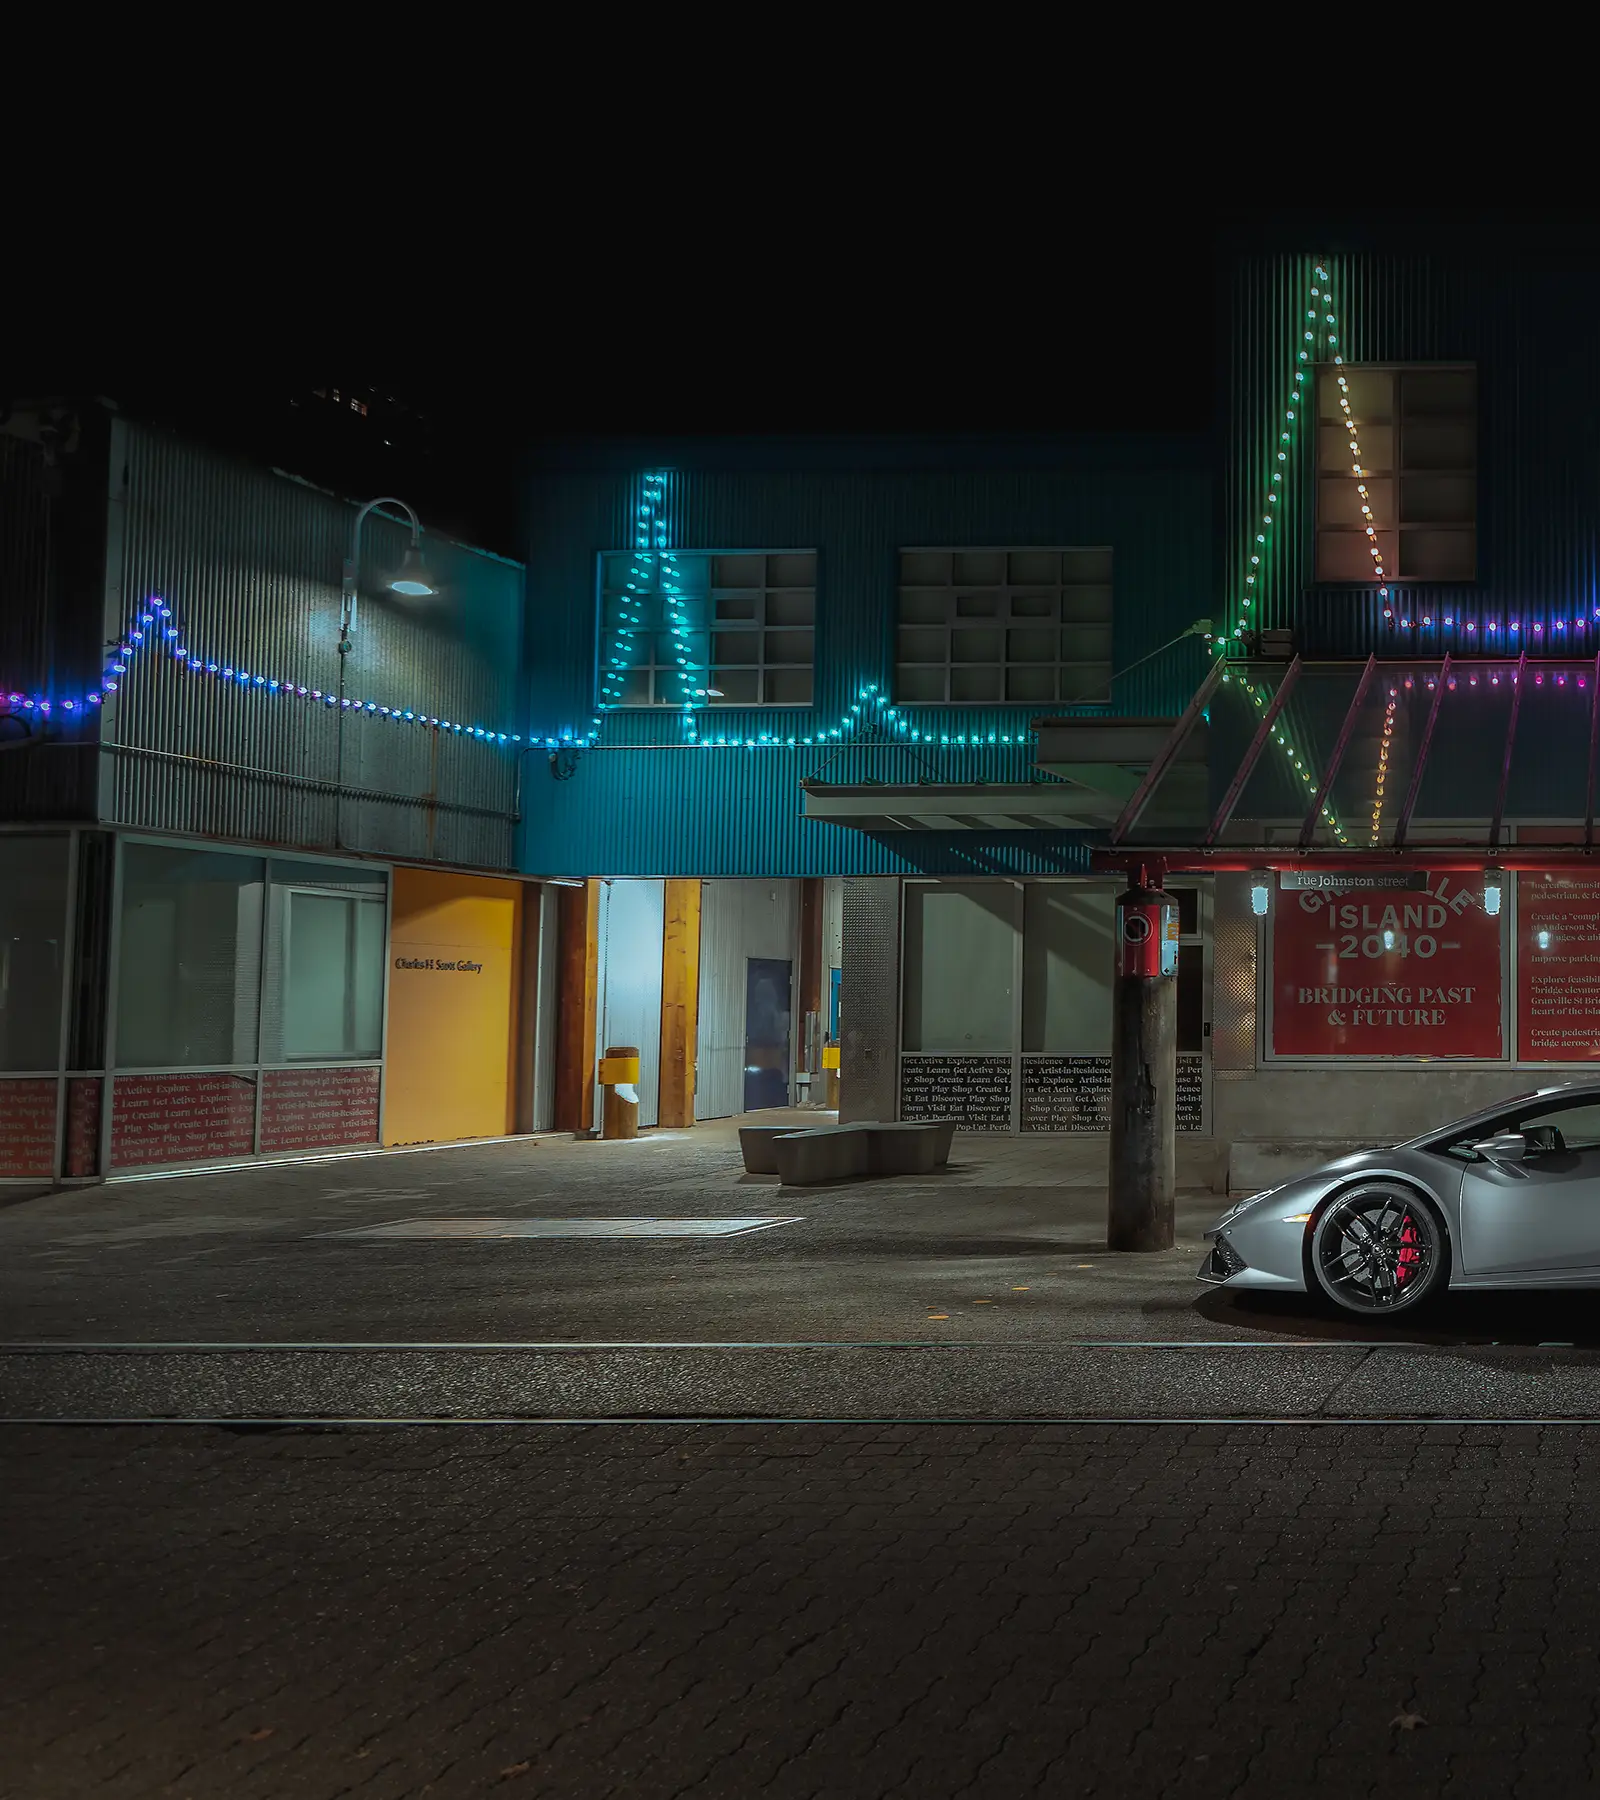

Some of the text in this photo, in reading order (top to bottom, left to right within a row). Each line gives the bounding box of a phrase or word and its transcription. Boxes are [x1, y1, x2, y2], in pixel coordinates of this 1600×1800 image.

[1318, 875, 1374, 887] Johnston
[1378, 876, 1408, 887] street
[1531, 892, 1580, 901] pedestrian,
[1329, 905, 1447, 929] ISLAND
[1531, 913, 1559, 921] Create
[1541, 923, 1584, 931] Anderson
[1556, 935, 1576, 943] ages
[1531, 955, 1567, 964] Improve
[395, 958, 425, 970] Charles
[457, 960, 483, 974] Gallery
[1531, 976, 1566, 985] Explore
[1299, 987, 1476, 1004] BRIDGING PAST
[1531, 997, 1572, 1005] Granville
[1573, 997, 1583, 1005] St
[1531, 1007, 1555, 1015] heart
[1557, 1007, 1568, 1015] of
[1568, 1007, 1583, 1015] the
[1328, 1009, 1446, 1026] & FUTURE
[1531, 1029, 1560, 1037] Create
[1531, 1039, 1559, 1048] bridge
[926, 1066, 994, 1074] Learn Get Active
[914, 1076, 935, 1084] Shop
[1043, 1076, 1074, 1085] Explore
[931, 1085, 948, 1094] Play
[952, 1086, 973, 1094] Shop
[969, 1095, 986, 1103] Play
[989, 1095, 1010, 1103] Shop
[1048, 1095, 1090, 1103] Learn Get
[927, 1104, 946, 1112] Visit
[966, 1104, 1001, 1112] Discover
[1030, 1105, 1051, 1114] Shop
[1031, 1123, 1105, 1131] Visit Eat Discover
